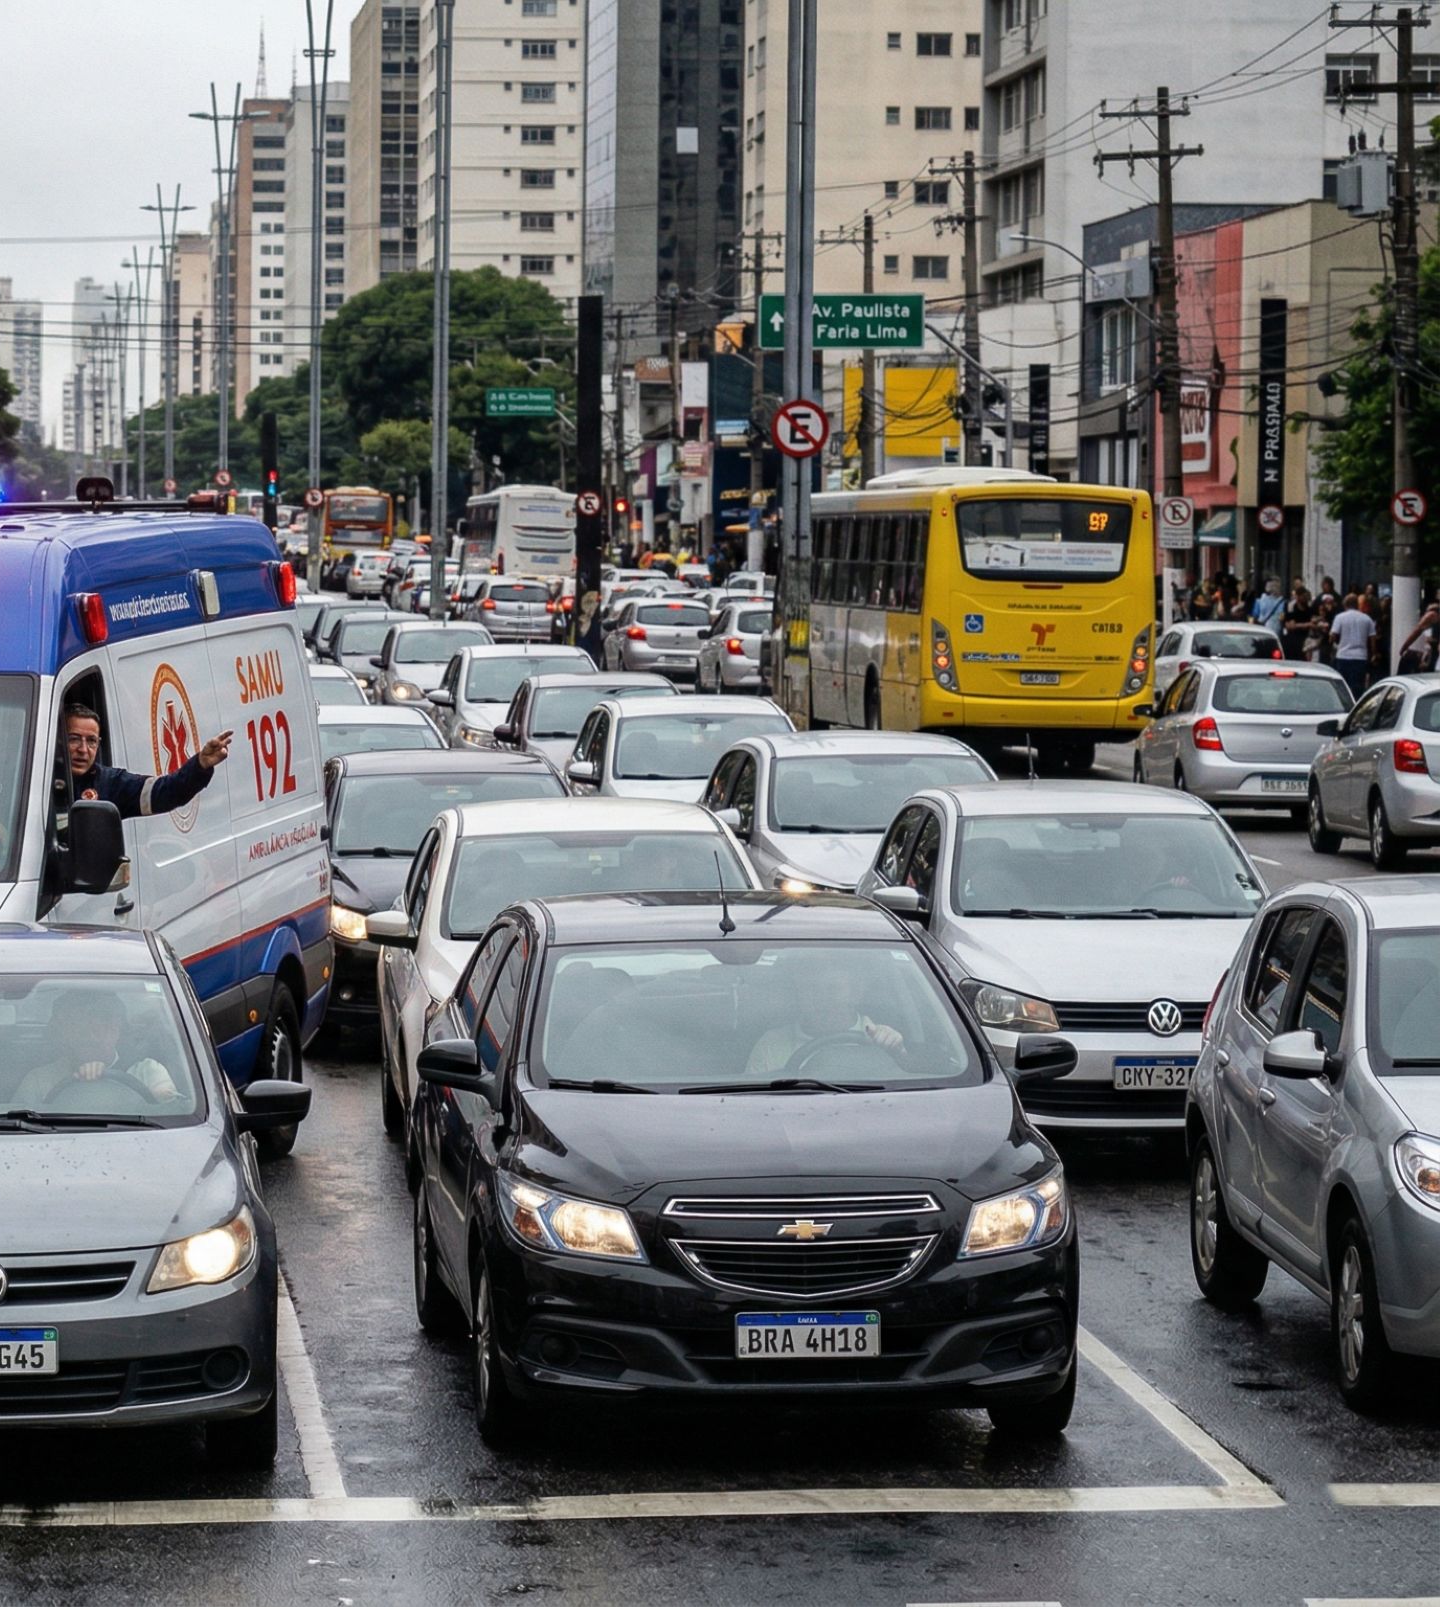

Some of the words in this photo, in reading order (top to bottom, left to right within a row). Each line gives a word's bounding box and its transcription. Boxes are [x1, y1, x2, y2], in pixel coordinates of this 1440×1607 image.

[812, 303, 836, 318] Av.
[841, 302, 910, 318] Paulista
[817, 324, 860, 339] Faria
[866, 324, 908, 339] Lima
[236, 650, 284, 704] SAMU
[247, 710, 297, 803] 192
[747, 1328, 795, 1354] BRA
[805, 1327, 868, 1353] 4H18
